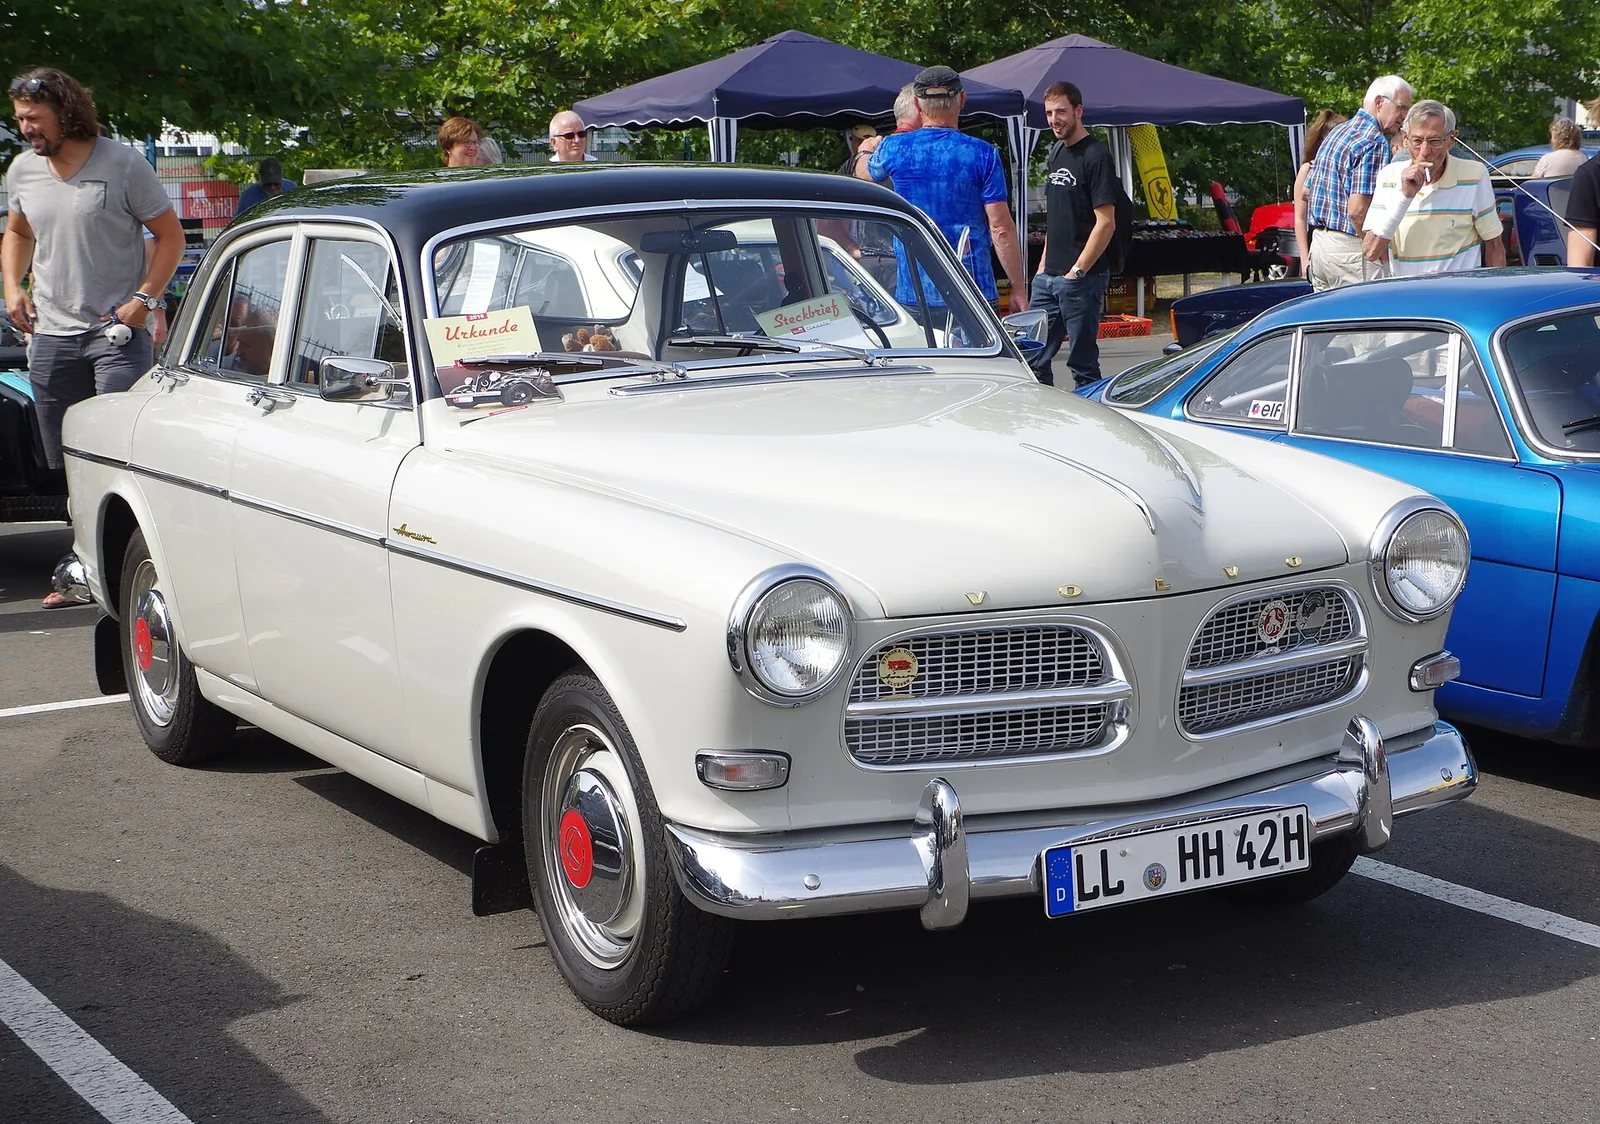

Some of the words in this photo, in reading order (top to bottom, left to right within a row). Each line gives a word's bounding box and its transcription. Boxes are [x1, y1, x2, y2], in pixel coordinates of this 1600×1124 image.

[774, 299, 839, 328] Steckbrief
[445, 319, 518, 341] Urkunde
[1261, 403, 1282, 417] elf
[964, 555, 1303, 606] VOLVO
[1075, 849, 1125, 902] LL
[1177, 829, 1225, 883] HH
[1236, 813, 1304, 870] 42H
[1056, 887, 1066, 902] D
